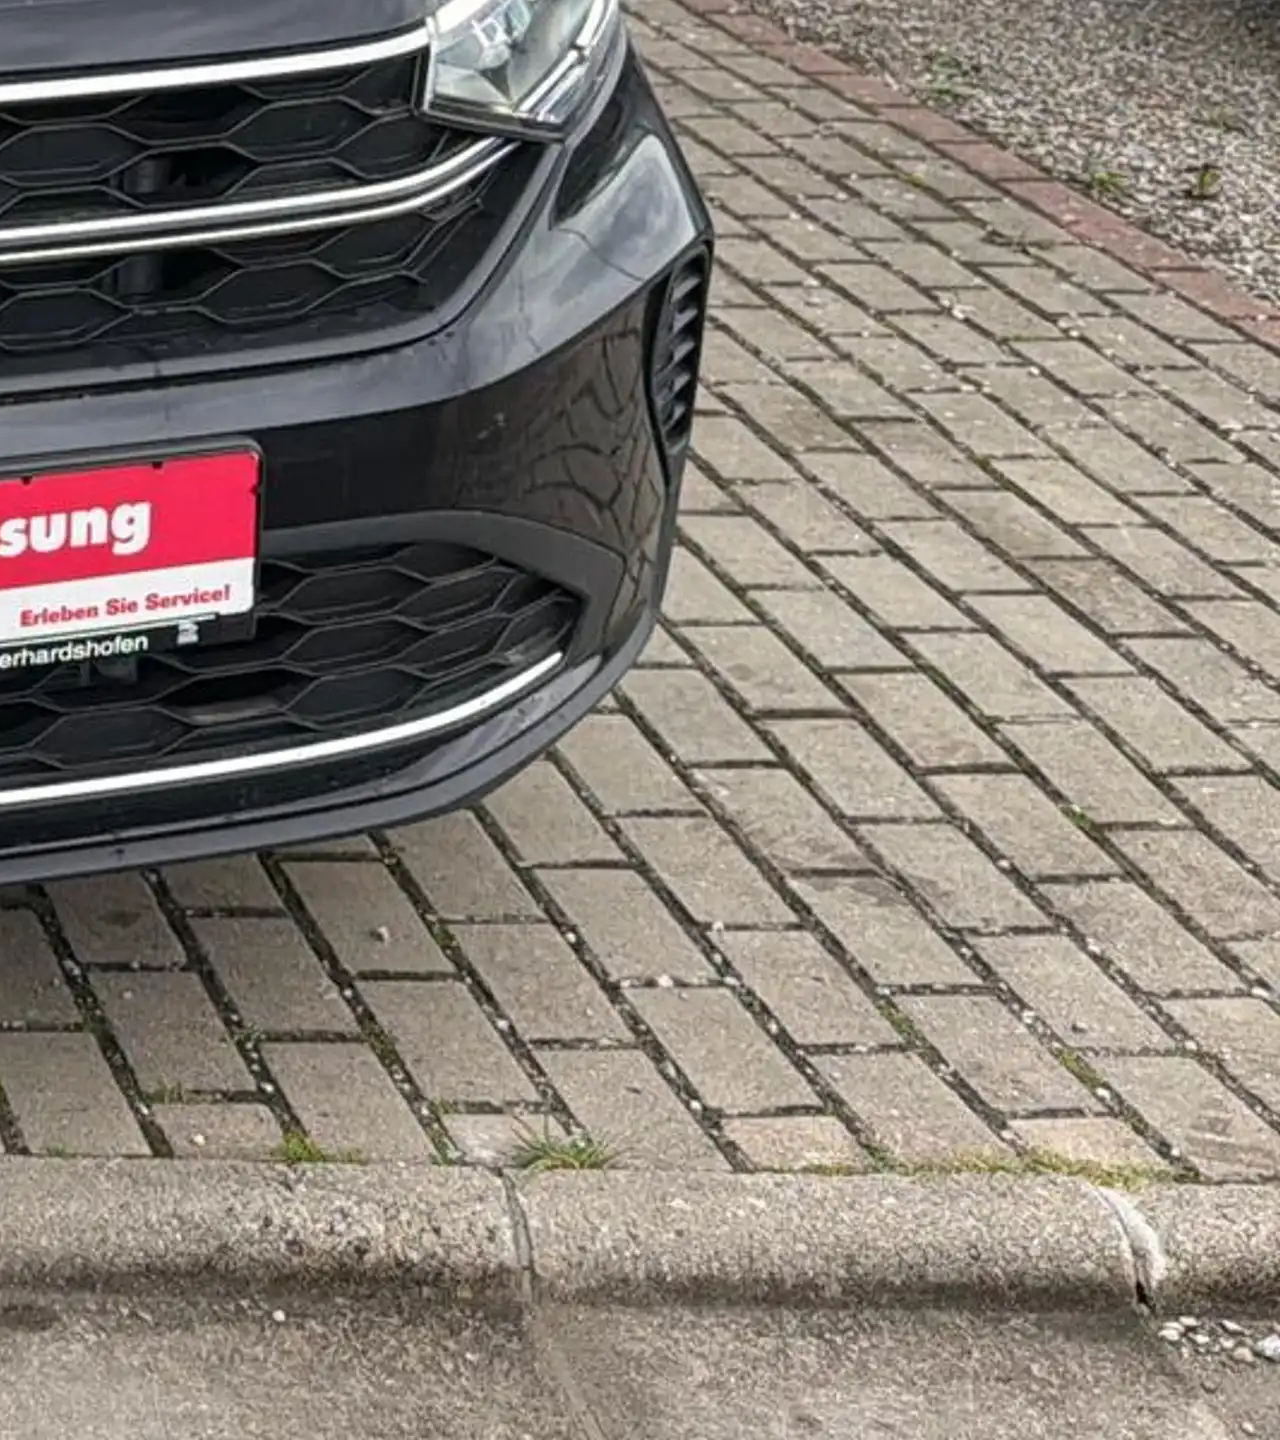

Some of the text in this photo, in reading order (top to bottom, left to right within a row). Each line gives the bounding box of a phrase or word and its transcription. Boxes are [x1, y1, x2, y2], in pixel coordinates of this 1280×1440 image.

[19, 583, 232, 628] Erleben Sie Service!
